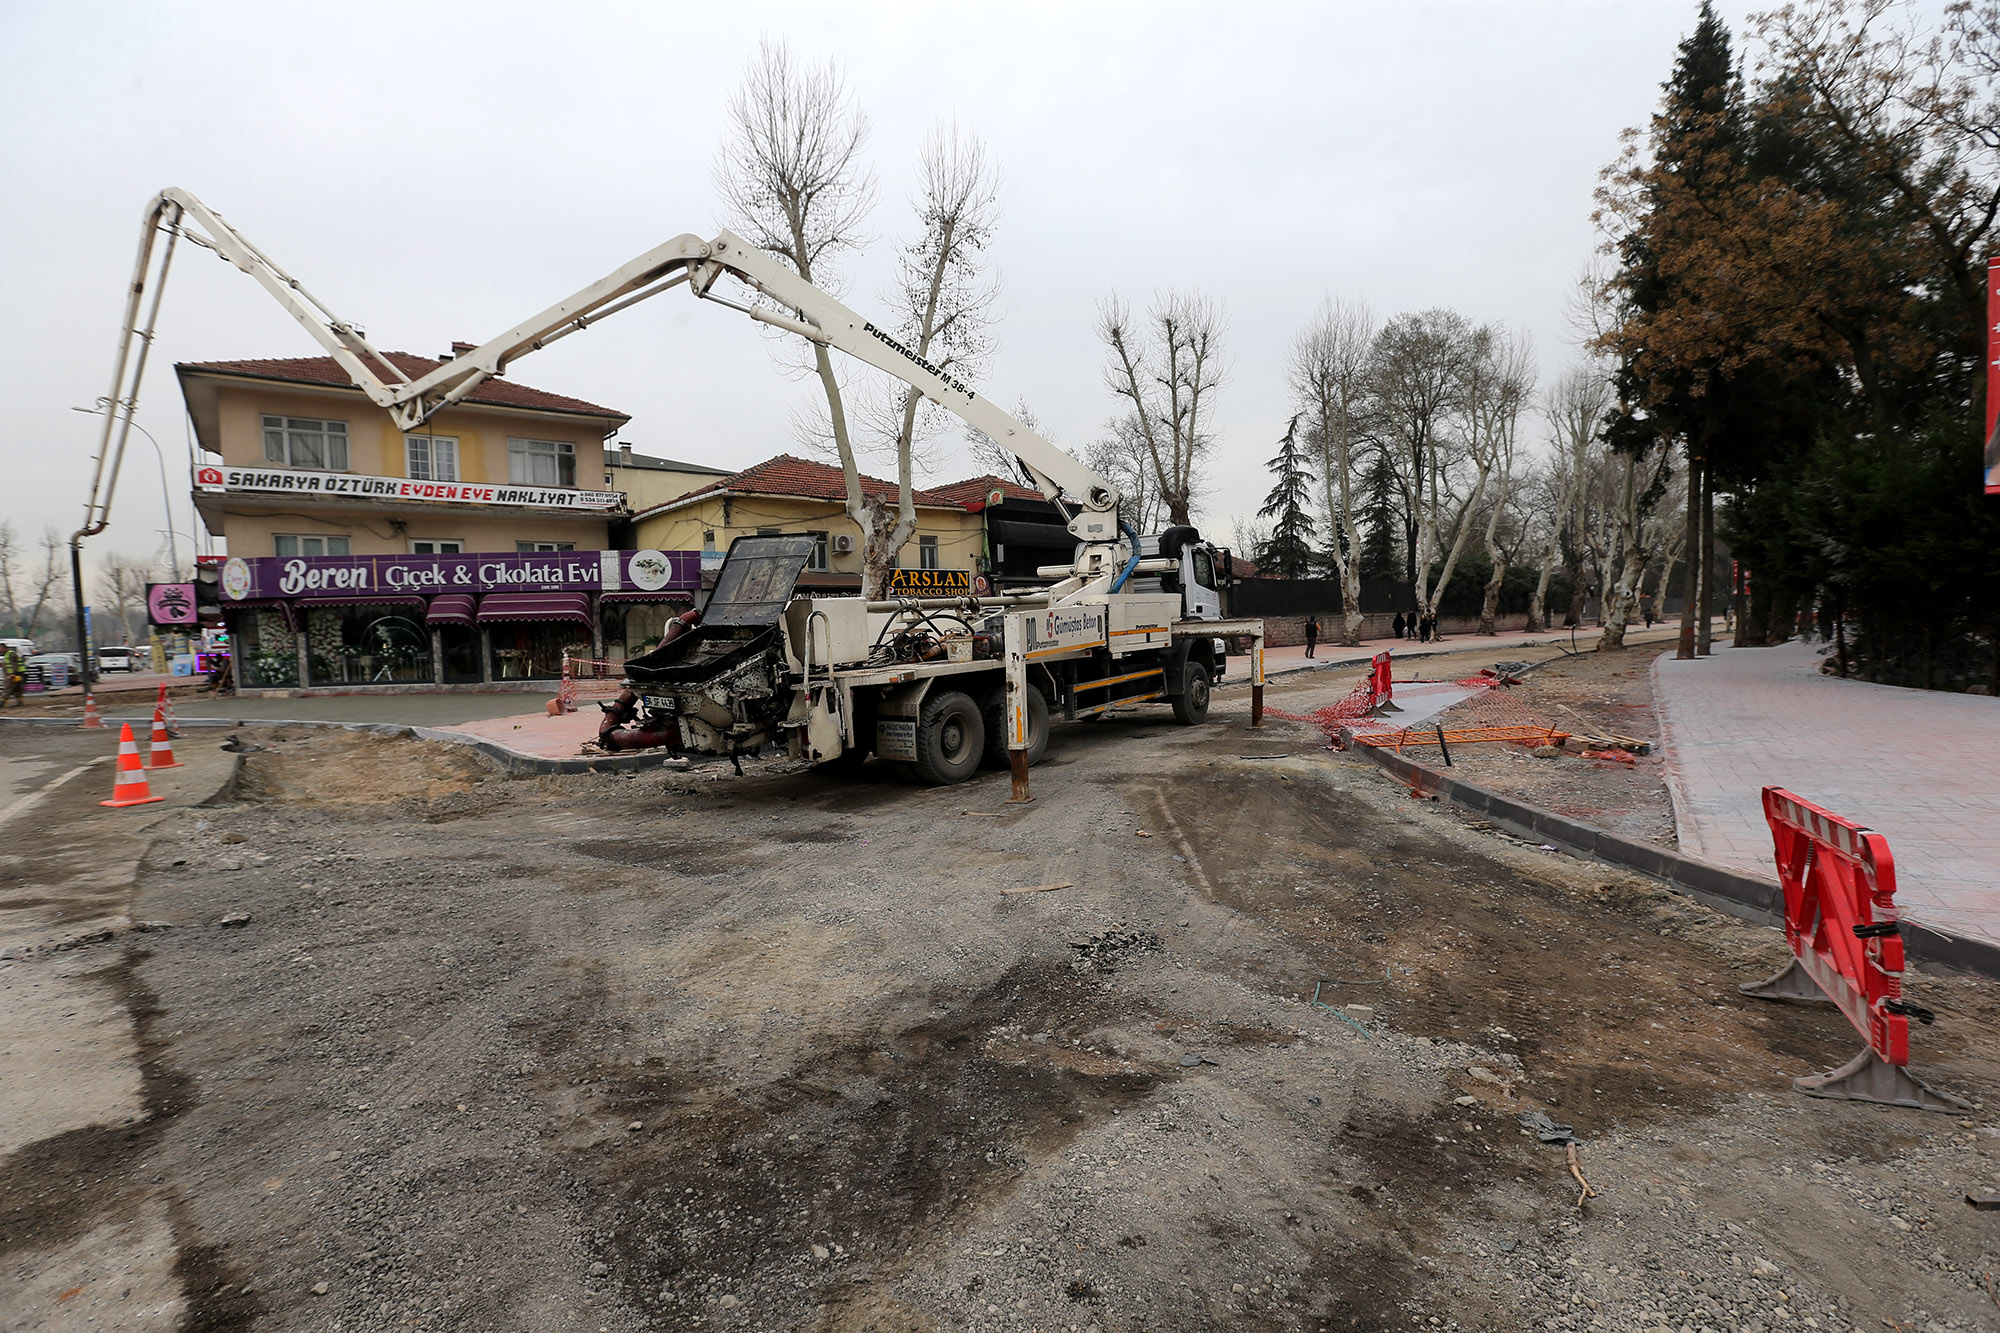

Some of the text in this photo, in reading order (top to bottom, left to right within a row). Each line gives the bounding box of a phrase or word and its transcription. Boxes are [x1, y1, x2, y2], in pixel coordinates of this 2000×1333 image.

[863, 322, 976, 400] Putzmeister M 38-4
[228, 472, 577, 505] SAKARYA ÖZTÜRK EVDEN EVE NAKLİYAT
[279, 559, 599, 594] Beren Çiçek & Çikolata Evi
[891, 569, 969, 587] ARSLAN
[895, 588, 943, 596] TOBACCO
[1083, 613, 1097, 630] Beton
